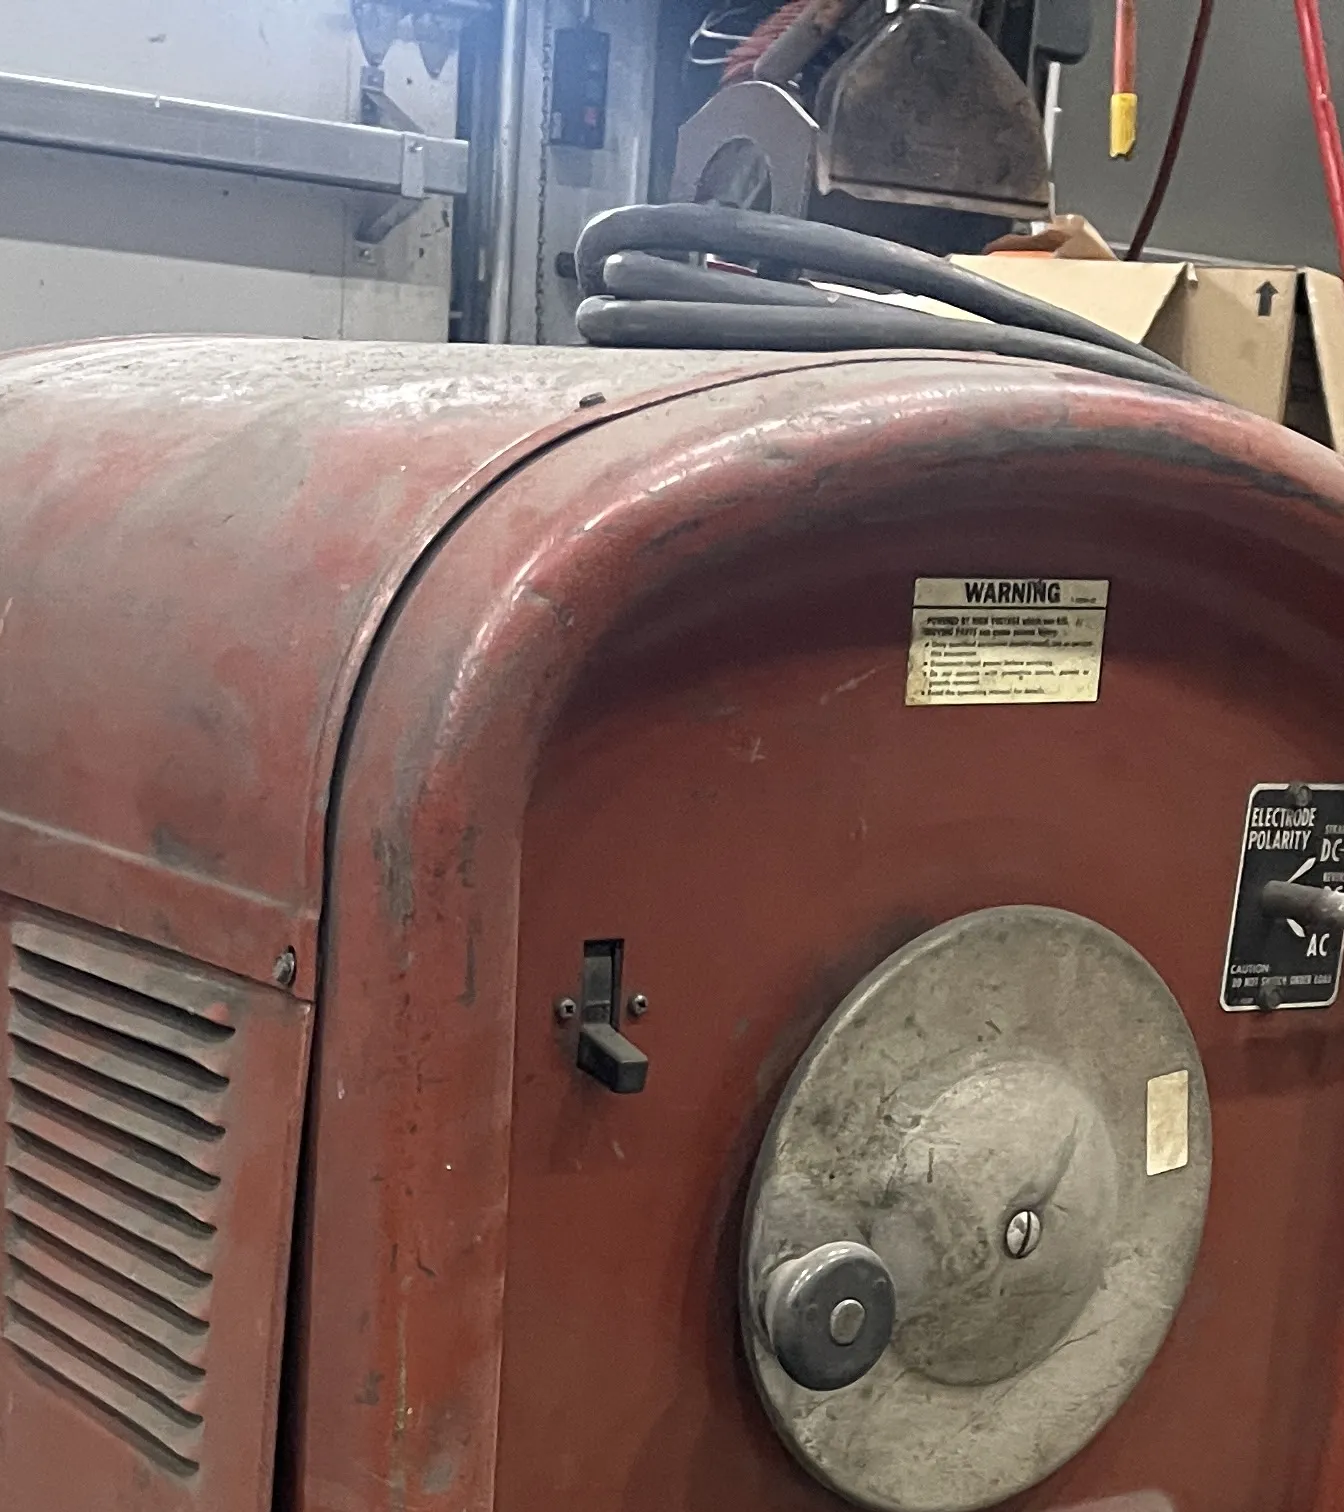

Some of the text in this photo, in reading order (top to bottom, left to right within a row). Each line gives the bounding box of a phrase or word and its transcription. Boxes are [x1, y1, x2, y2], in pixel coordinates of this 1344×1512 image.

[964, 581, 1062, 604] WARNING
[1250, 806, 1317, 828] ELECTRODE
[1247, 829, 1312, 851] POLARITY
[1306, 933, 1330, 958] AC
